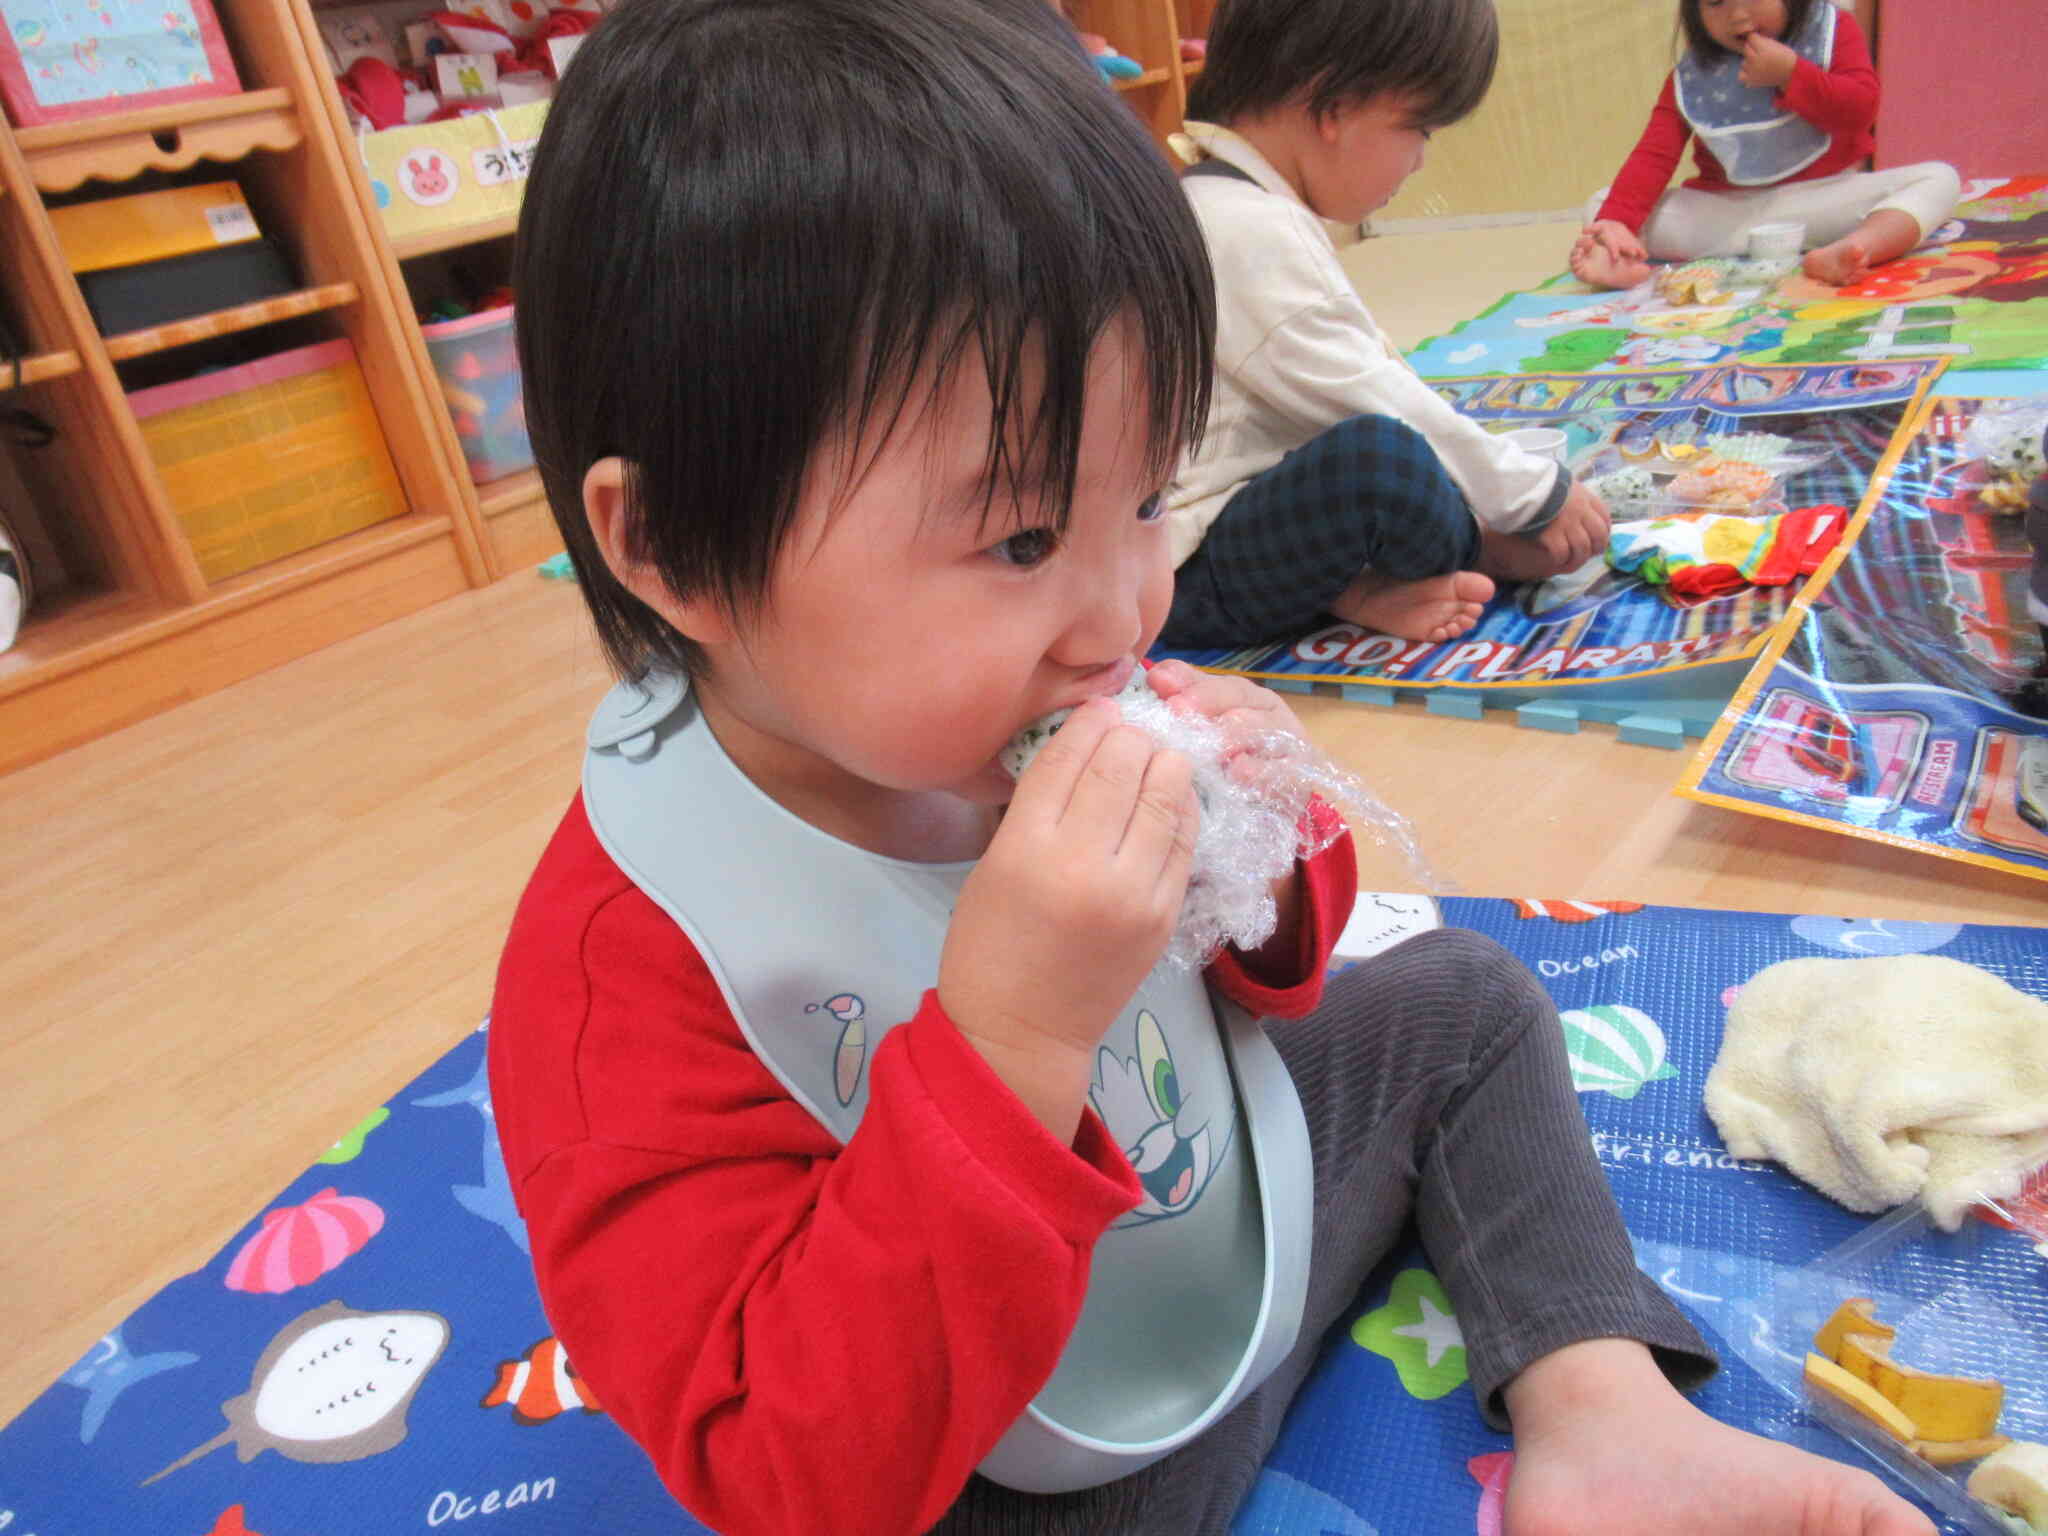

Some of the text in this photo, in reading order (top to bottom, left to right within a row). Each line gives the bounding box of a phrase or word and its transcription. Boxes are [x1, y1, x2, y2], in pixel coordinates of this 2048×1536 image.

[1295, 623, 1436, 673] GO!
[1537, 944, 1638, 977] Ocean
[427, 1476, 556, 1527] Ocean
